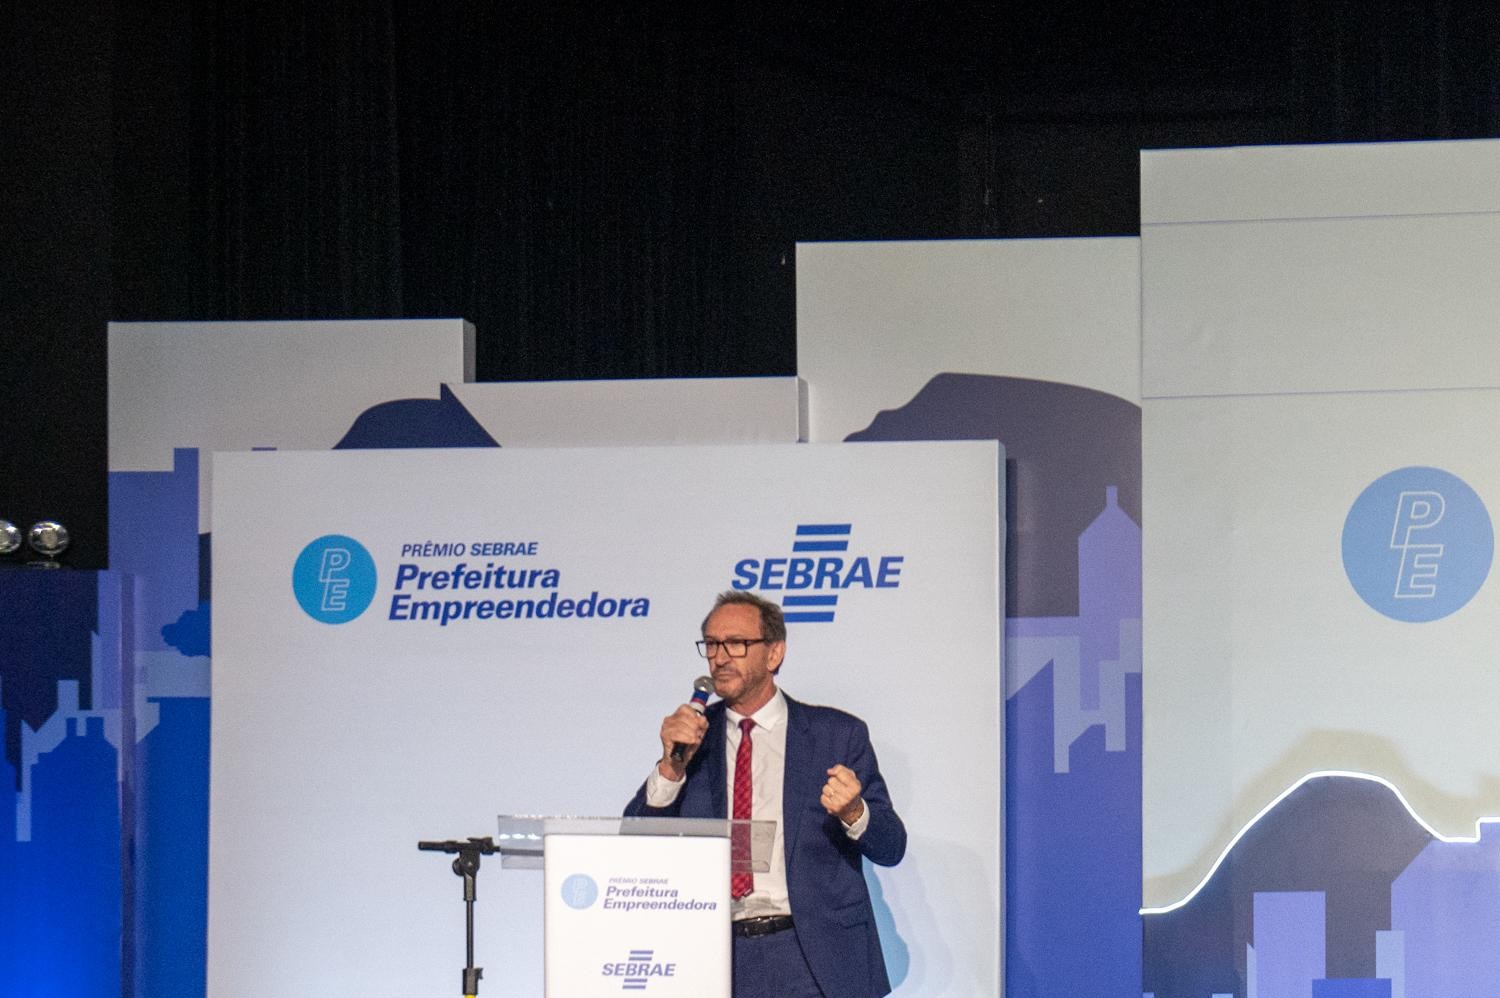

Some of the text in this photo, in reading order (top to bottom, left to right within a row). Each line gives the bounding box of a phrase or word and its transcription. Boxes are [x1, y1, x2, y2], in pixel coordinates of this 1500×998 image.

[401, 540, 539, 557] PRÊMIO SEBRAE
[395, 563, 561, 590] Prefeitura
[731, 556, 904, 590] SEBRAE
[389, 591, 650, 626] Empreendedora
[606, 886, 679, 898] Prefeitura
[603, 898, 717, 911] Empreendedora
[602, 963, 676, 976] SEBRAE
